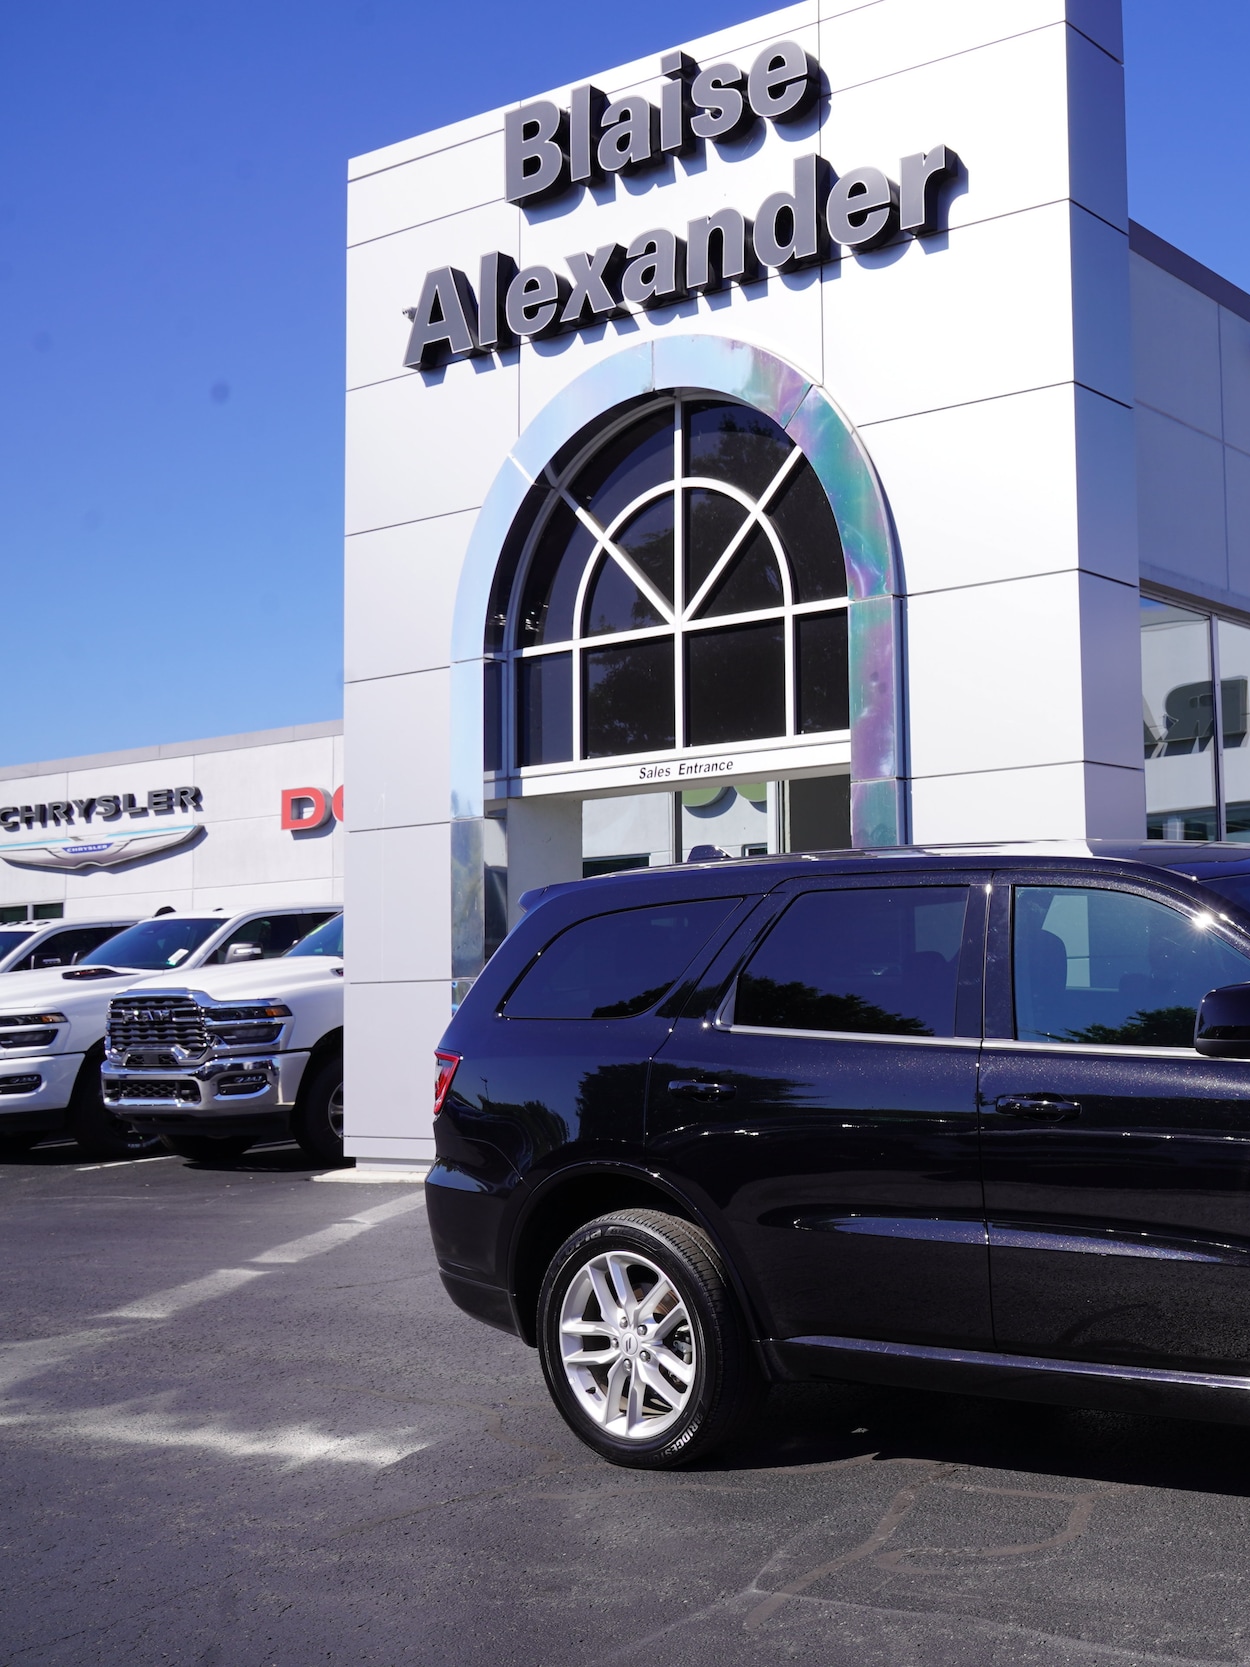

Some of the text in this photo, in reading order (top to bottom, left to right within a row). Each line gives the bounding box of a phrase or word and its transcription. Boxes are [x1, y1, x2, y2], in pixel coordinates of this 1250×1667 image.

[503, 39, 815, 205] Blaise
[402, 144, 955, 370] Alexander
[639, 760, 734, 779] Sales Entrance
[0, 785, 201, 829] CHRYSLER
[281, 783, 344, 832] D
[66, 843, 108, 854] CHRYSLER
[636, 1412, 704, 1464] BRIDGESTO
